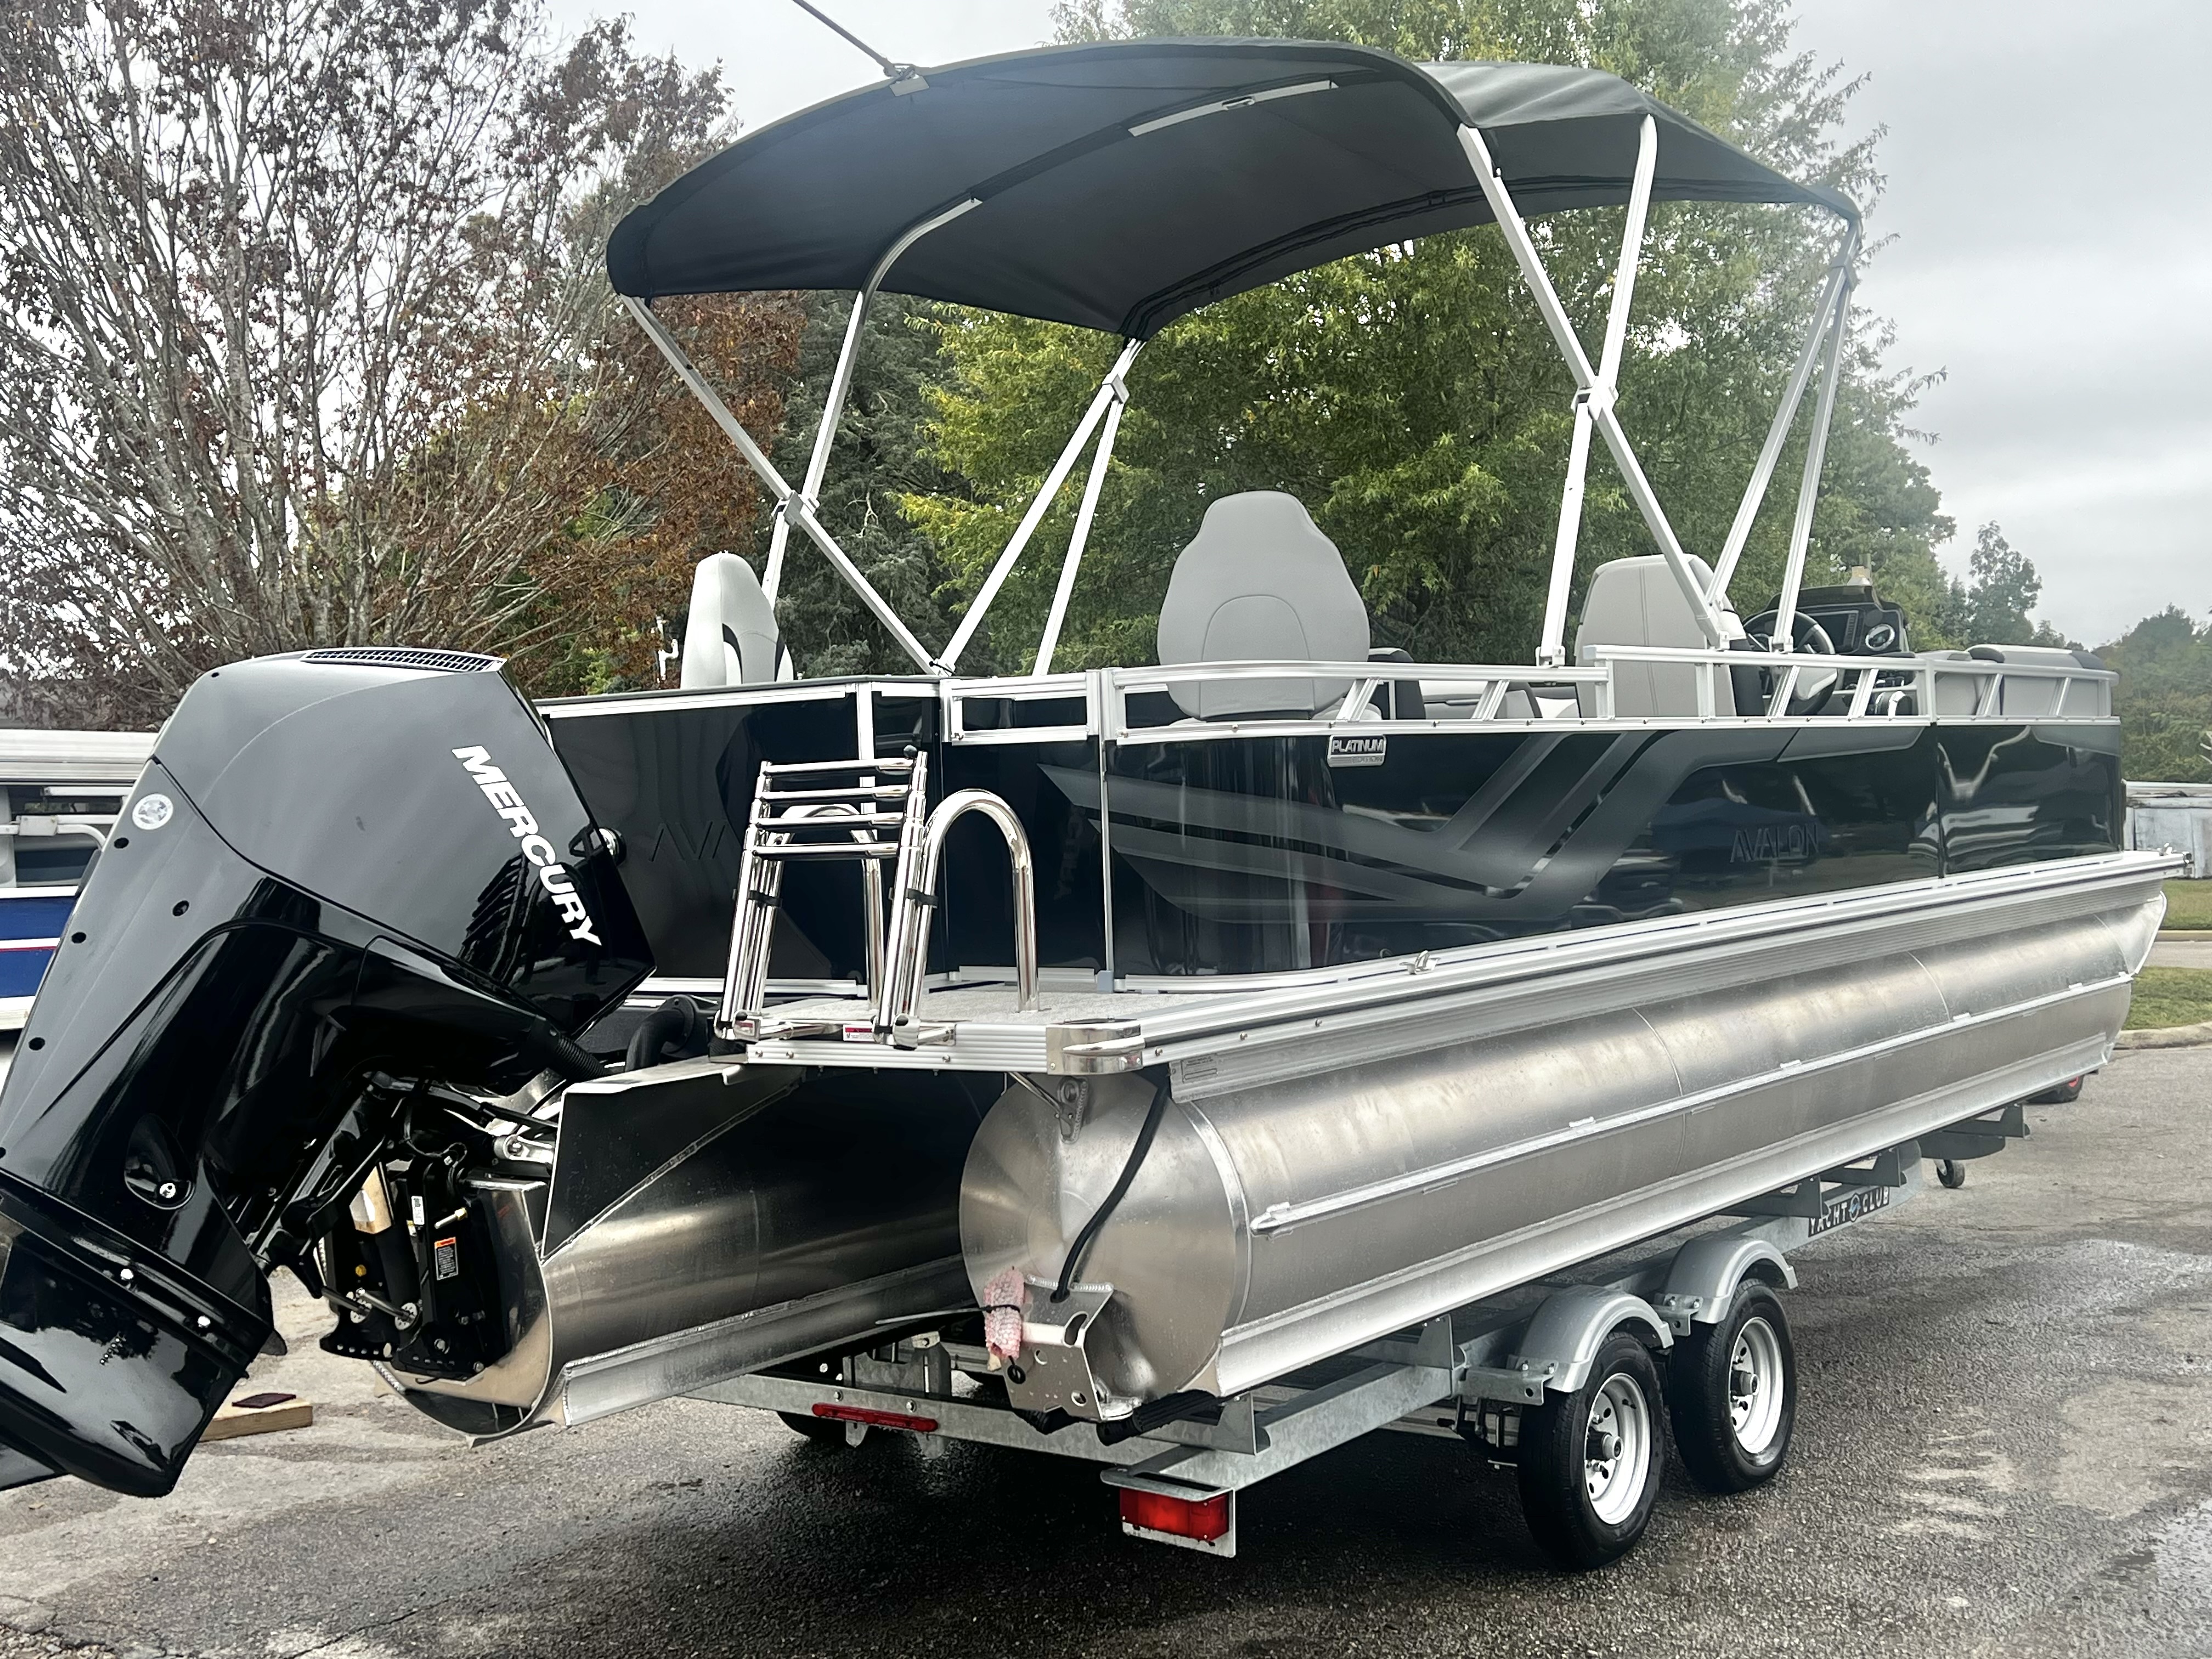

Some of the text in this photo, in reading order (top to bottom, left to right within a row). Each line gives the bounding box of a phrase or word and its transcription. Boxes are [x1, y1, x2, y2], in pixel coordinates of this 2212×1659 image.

[1332, 739, 1384, 753] PLATINUM
[452, 744, 602, 946] MERCURY
[1729, 822, 1819, 863] AVALON
[1862, 1186, 1889, 1213] CLUB
